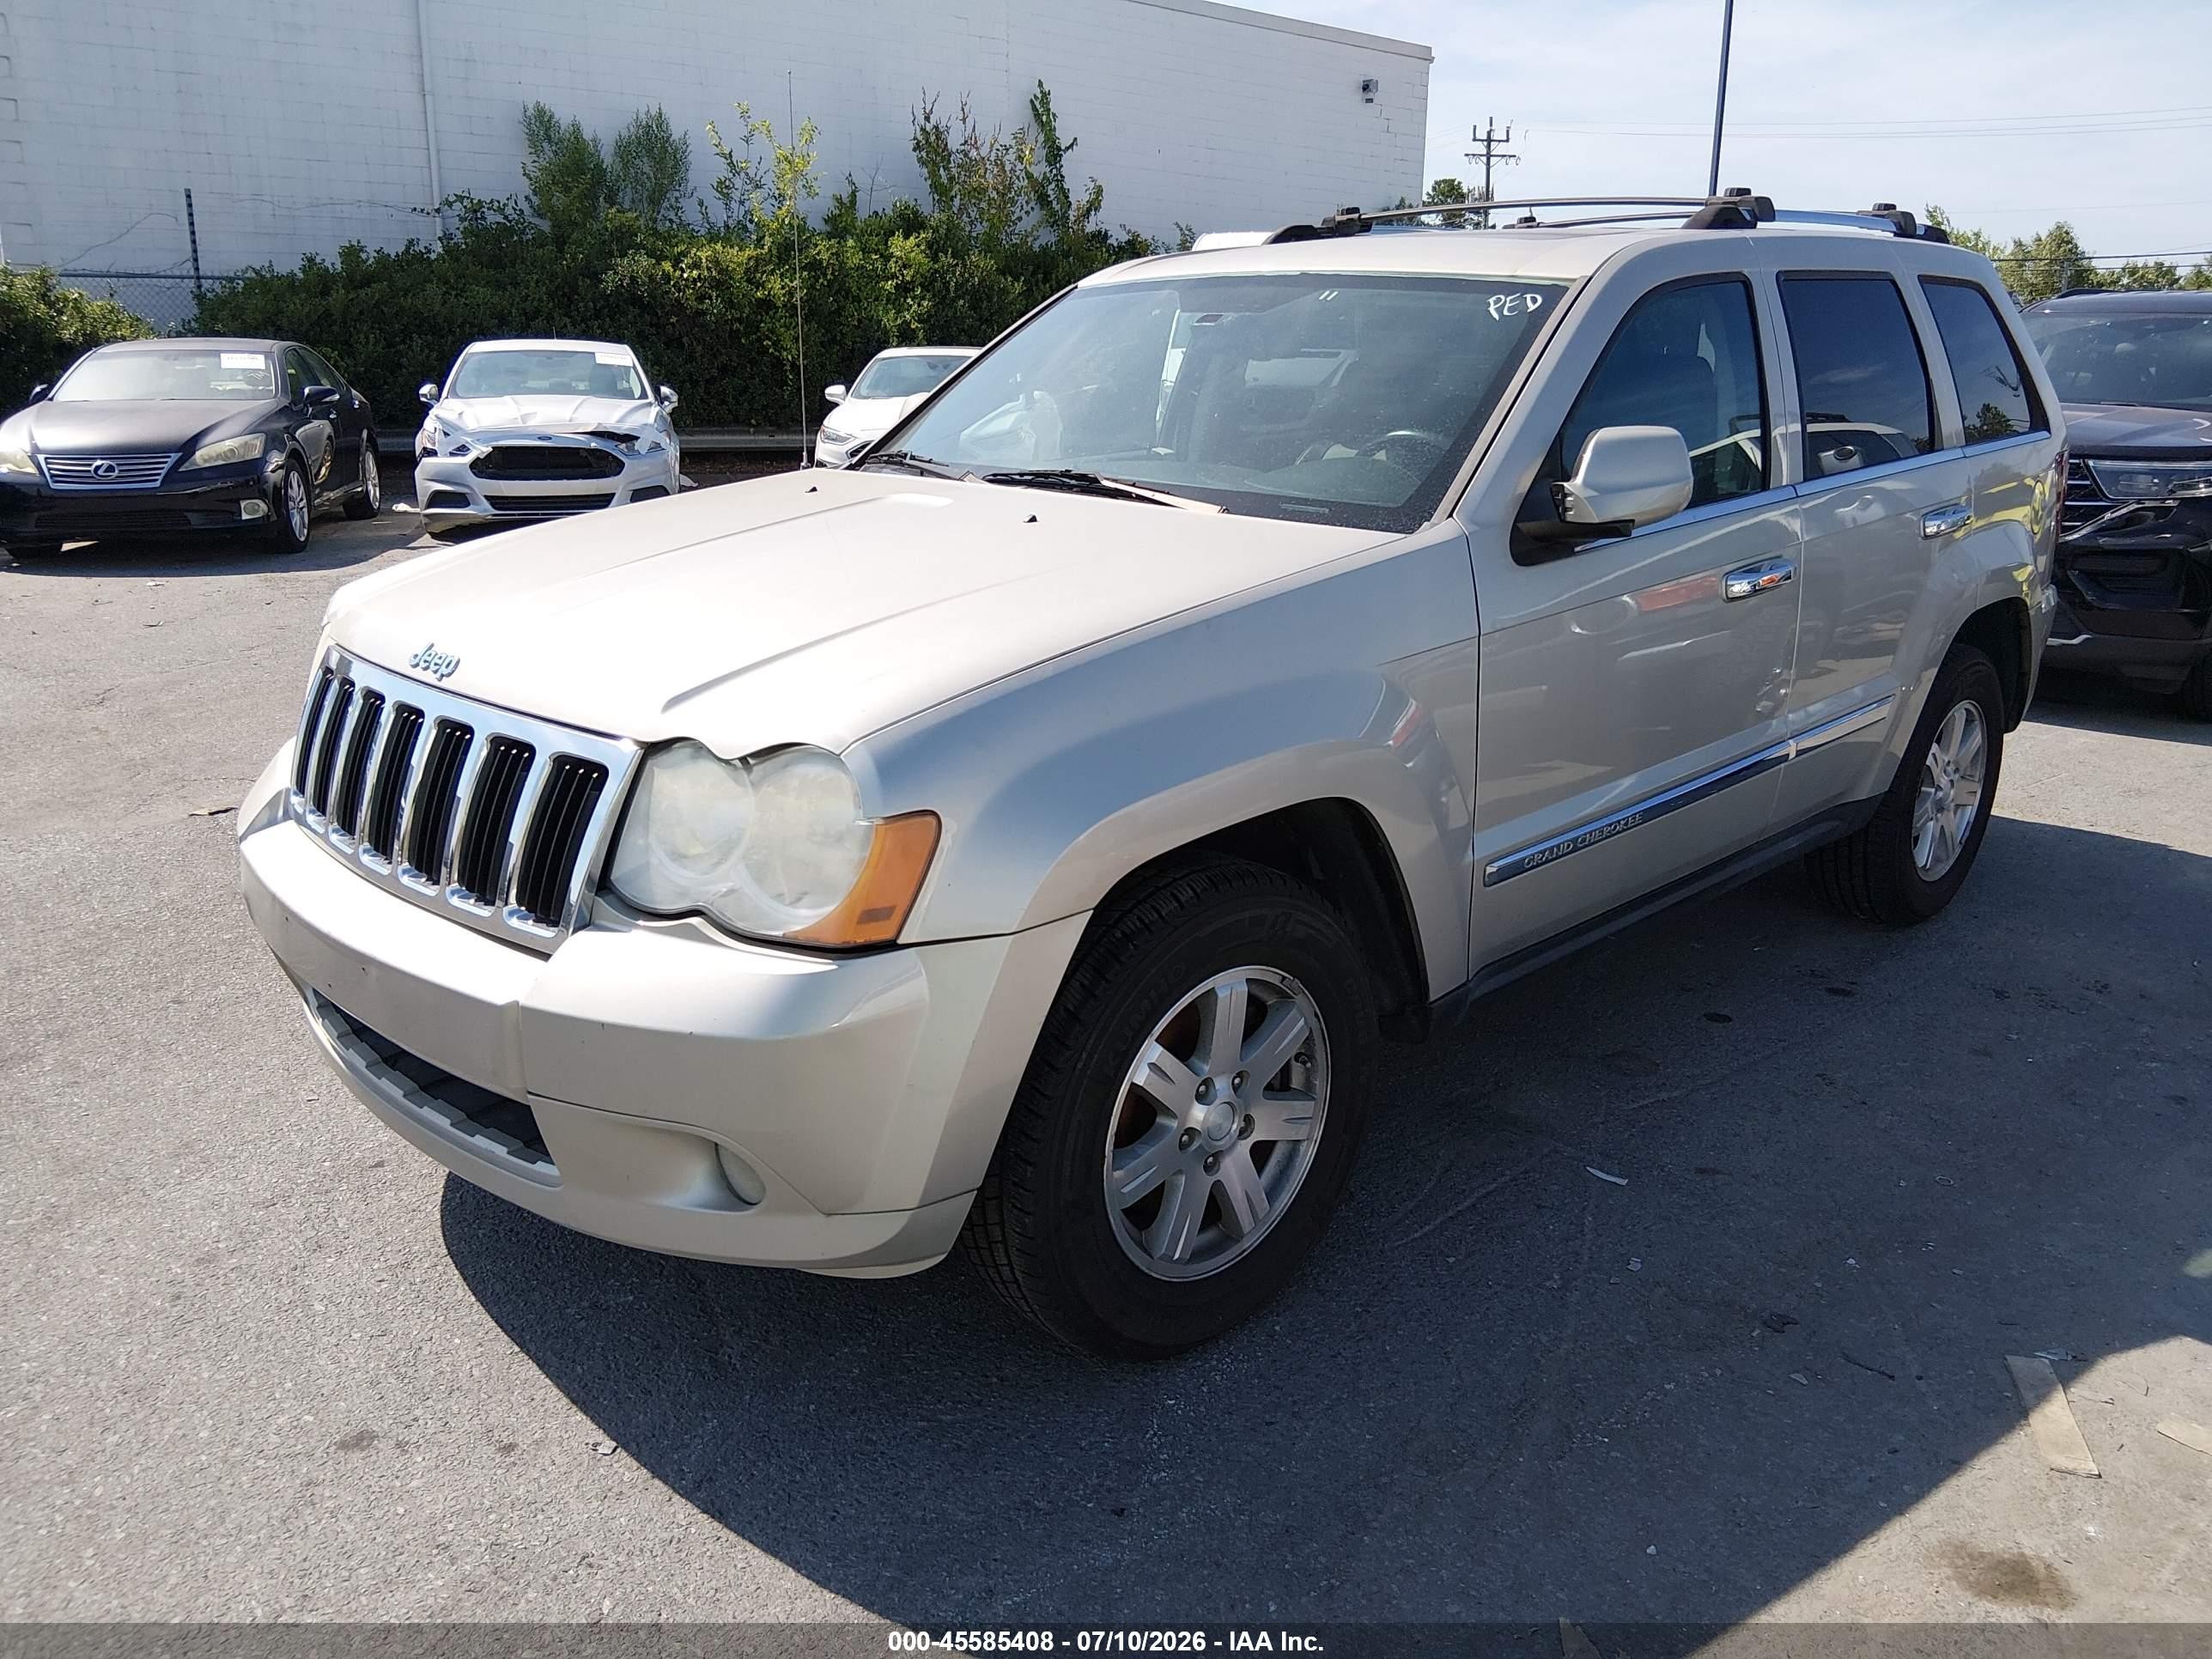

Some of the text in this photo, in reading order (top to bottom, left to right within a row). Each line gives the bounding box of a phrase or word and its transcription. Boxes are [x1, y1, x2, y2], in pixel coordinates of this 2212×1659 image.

[1486, 293, 1542, 321] PED
[409, 642, 460, 682] Jeep
[1524, 812, 1644, 868] GRAND CHEROKEE
[1104, 963, 1187, 1078] KUMHO
